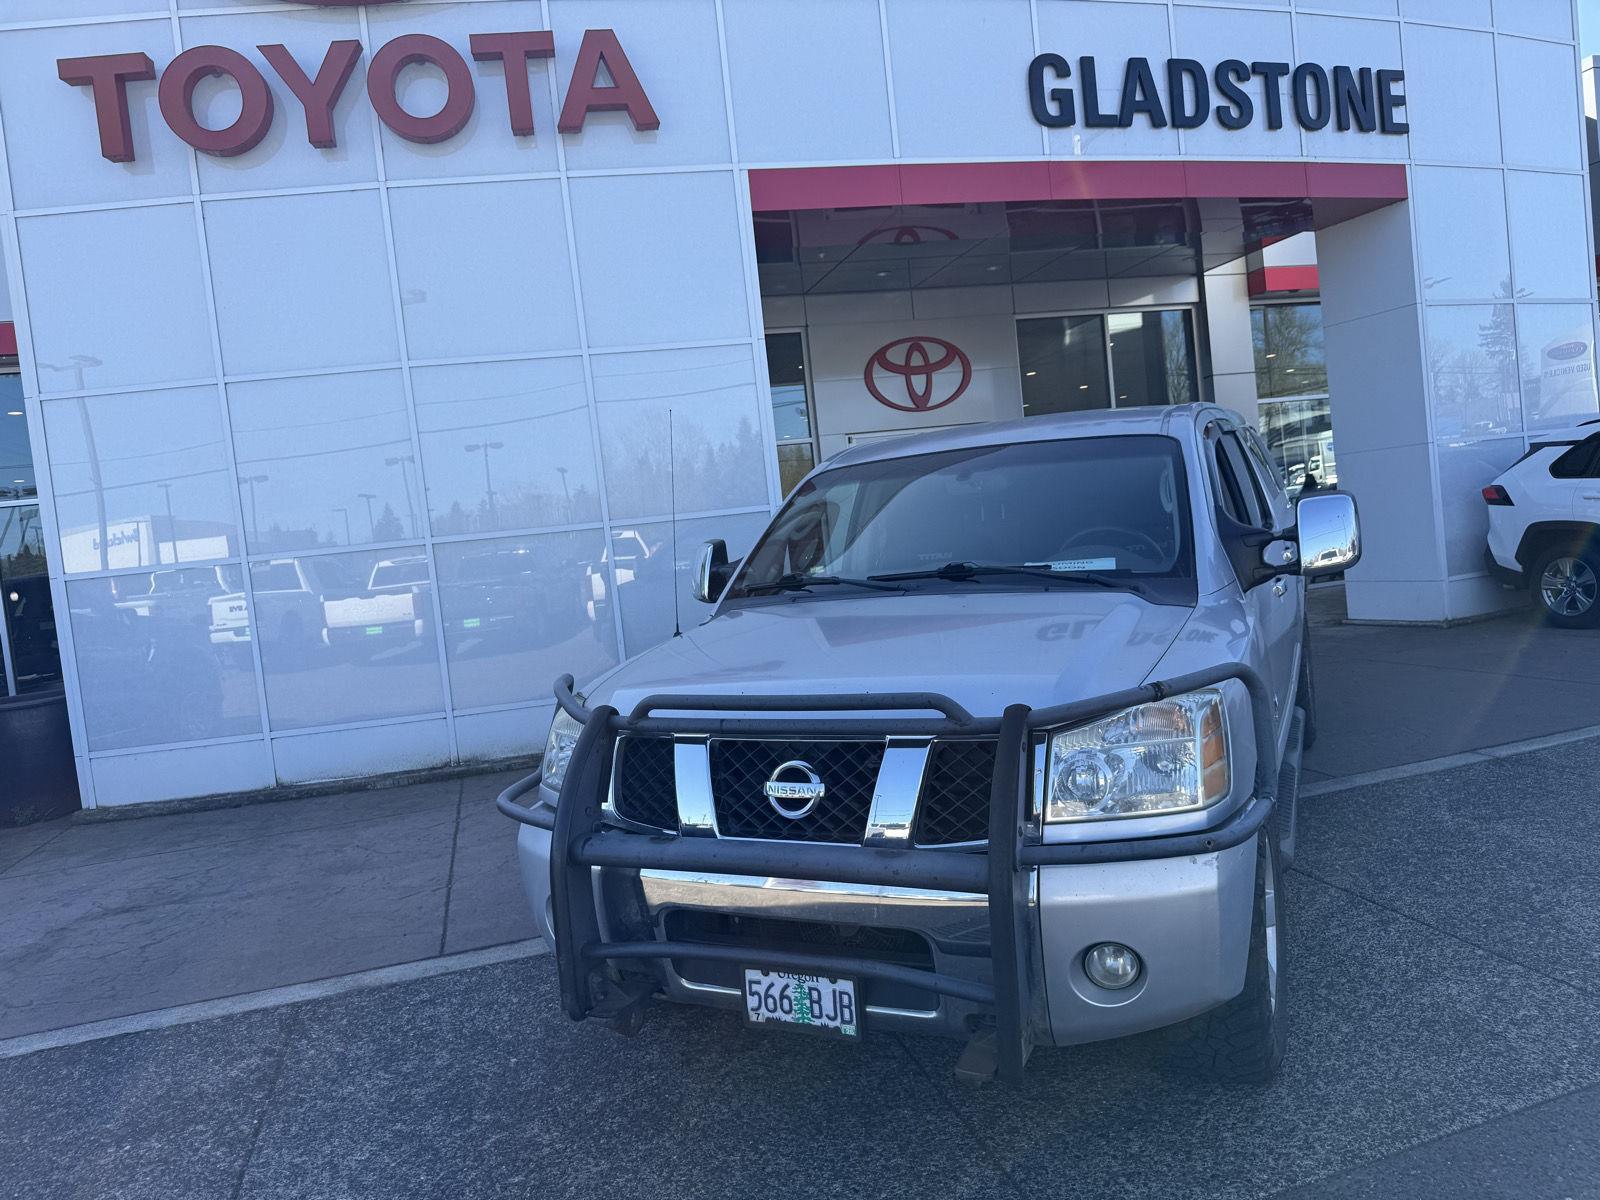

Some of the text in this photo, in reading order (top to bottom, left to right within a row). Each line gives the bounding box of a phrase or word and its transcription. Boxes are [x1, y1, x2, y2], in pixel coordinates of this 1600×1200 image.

[57, 29, 660, 163] TOYOTA
[1028, 53, 1410, 134] GLADSTONE
[767, 783, 817, 796] NISSAN
[748, 979, 855, 1025] 566 BJB
